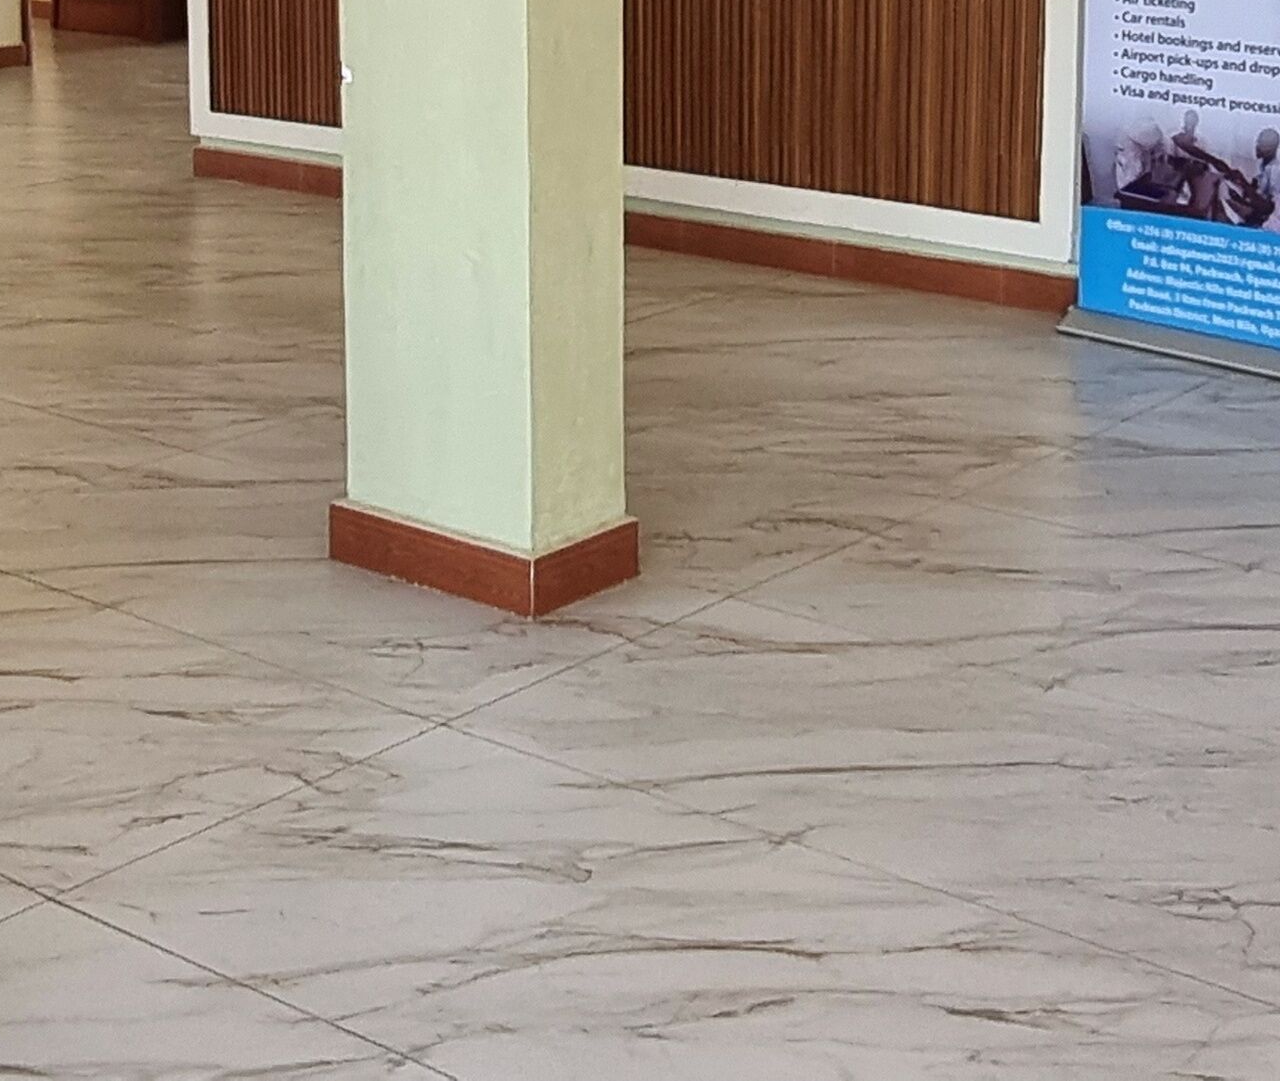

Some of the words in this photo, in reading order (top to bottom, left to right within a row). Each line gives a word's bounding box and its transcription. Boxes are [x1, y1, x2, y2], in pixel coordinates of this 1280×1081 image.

[1122, 11, 1142, 23] Car
[1146, 14, 1185, 28] rentals
[1122, 31, 1154, 43] Hotel
[1158, 33, 1213, 51] bookings
[1217, 40, 1240, 52] and
[1121, 49, 1164, 65] Airport
[1167, 54, 1218, 70] pick-ups
[1222, 59, 1246, 72] and
[1120, 67, 1156, 82] Cargo
[1159, 70, 1213, 89] handling
[1120, 85, 1144, 98] Visa
[1148, 90, 1169, 101] and
[1172, 94, 1225, 108] passport
